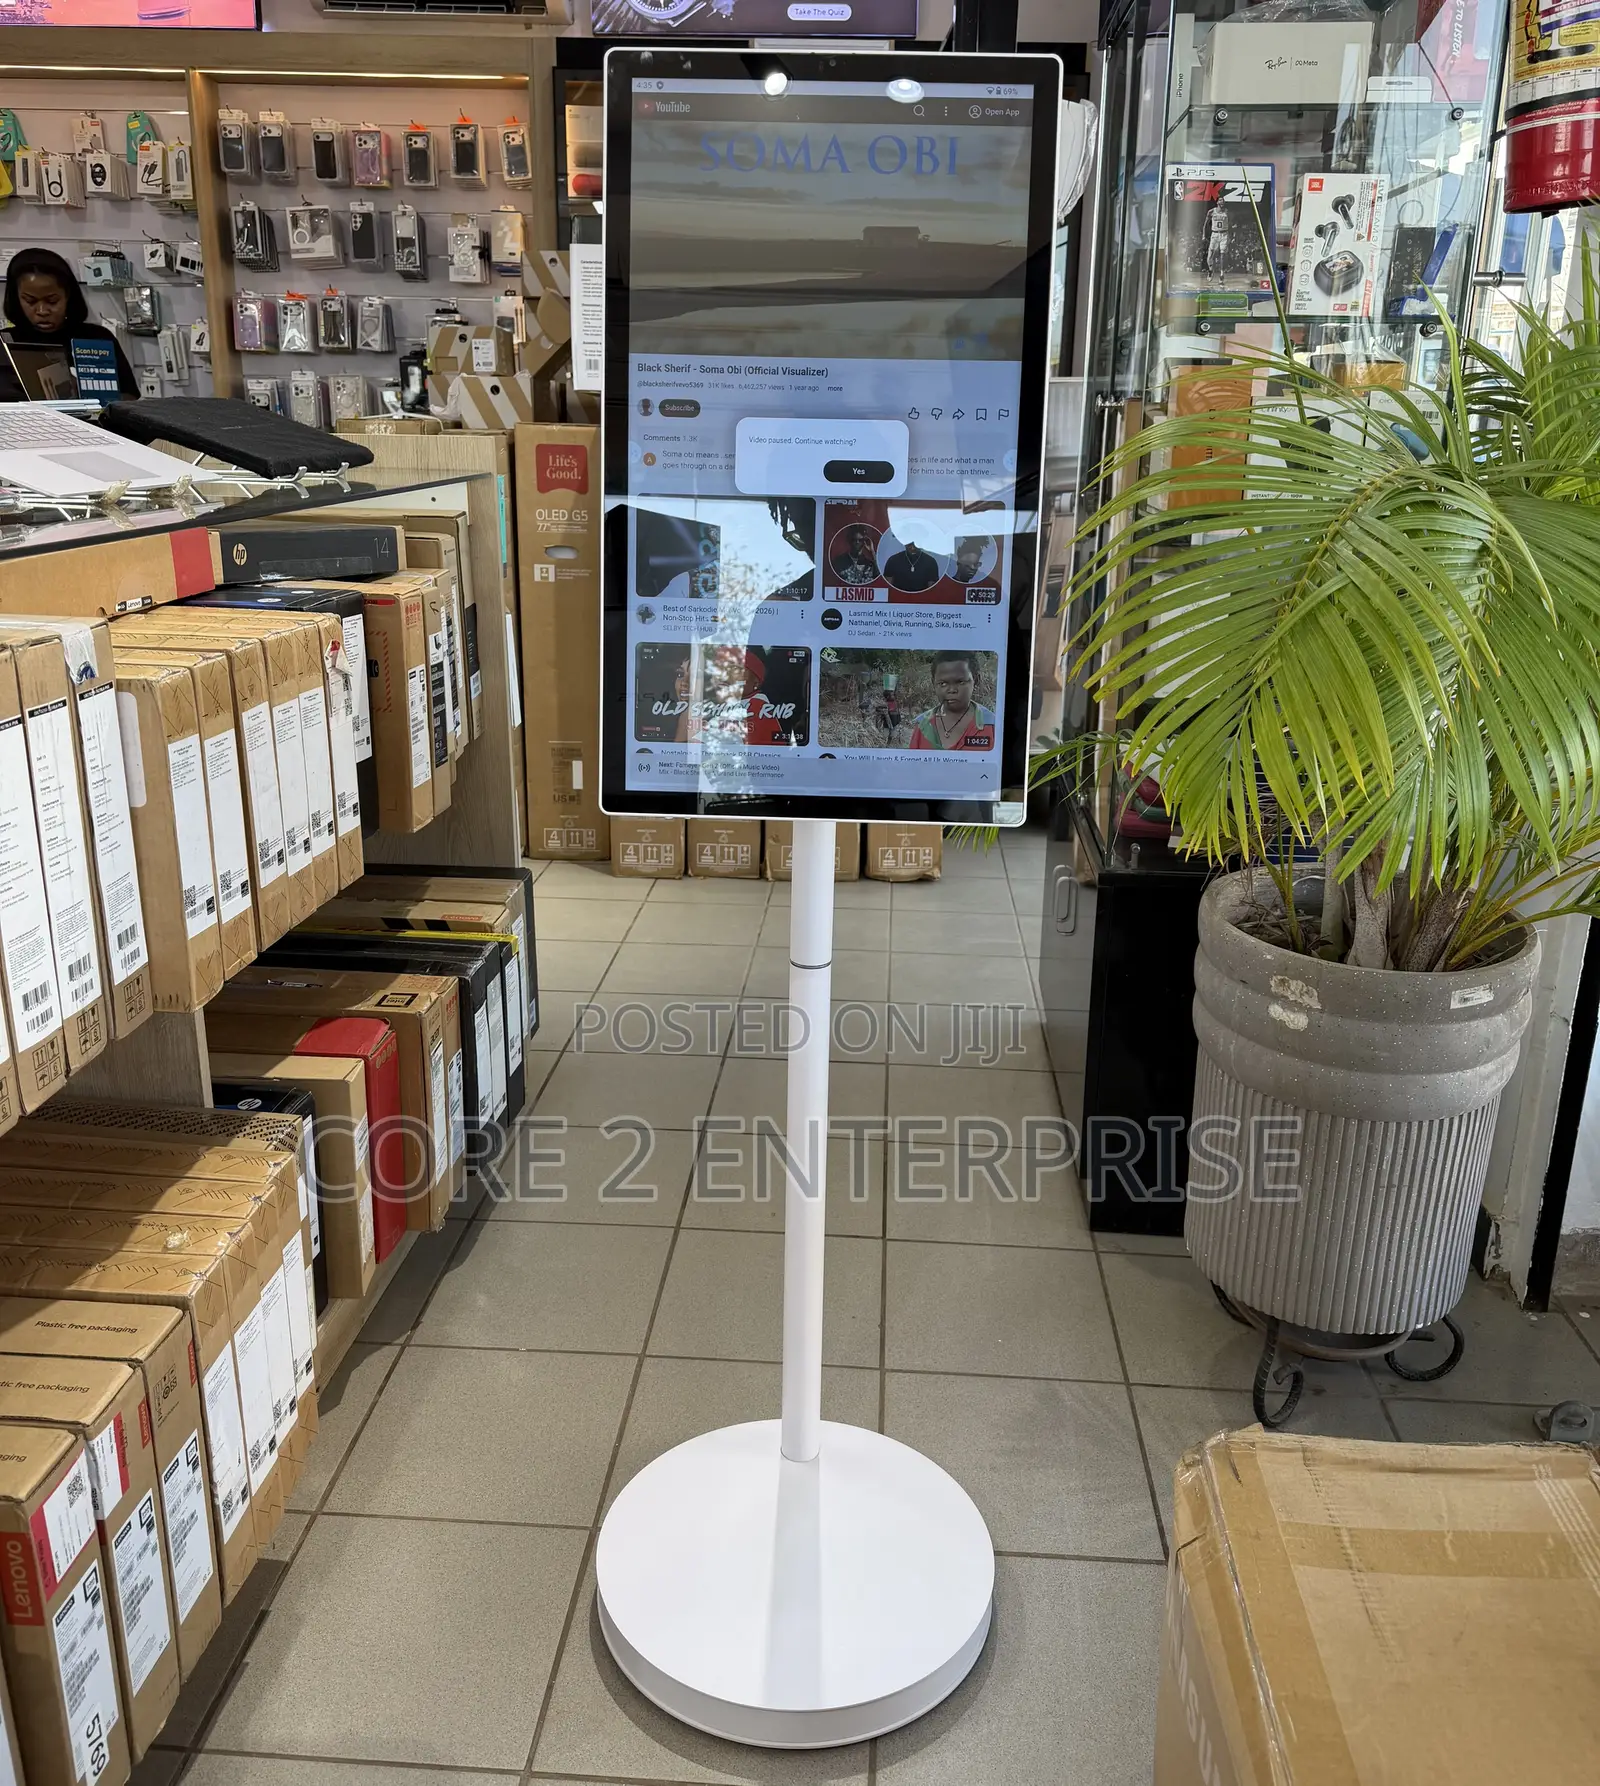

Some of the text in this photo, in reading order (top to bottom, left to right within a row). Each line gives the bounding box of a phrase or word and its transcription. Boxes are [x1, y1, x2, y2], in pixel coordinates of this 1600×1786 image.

[795, 8, 845, 17] Take The Quiz
[636, 81, 1018, 96] 4:35 69%
[1176, 73, 1184, 98] iPhone
[656, 101, 1020, 118] YouTube Open App
[700, 132, 960, 176] SOMA OBI
[1187, 169, 1216, 177] PS5
[637, 363, 662, 373] Black
[664, 364, 691, 374] Sherif
[699, 364, 725, 374] Soma
[727, 365, 742, 374] Obi
[744, 365, 779, 376] (Official
[780, 366, 829, 378] Visualizer)
[665, 404, 695, 412] Subscribe
[643, 434, 680, 442] Comments
[768, 437, 793, 445] paused.
[824, 438, 856, 446] watching?
[662, 450, 682, 458] Soma
[548, 454, 578, 467] Life's
[680, 462, 707, 470] through
[852, 467, 866, 475] Yes
[546, 468, 582, 480] Good.
[536, 508, 588, 522] OLED G5
[233, 537, 390, 565] hp 14
[836, 587, 874, 601] LASMID
[663, 604, 678, 612] Best
[662, 615, 694, 623] Non-Stop
[892, 611, 914, 620] Liquor
[915, 612, 934, 620] Store,
[936, 612, 962, 620] Biggest
[848, 620, 882, 628] Nathaniel,
[884, 620, 904, 628] Olivia,
[904, 621, 934, 630] Running,
[935, 622, 951, 630] Sika,
[652, 700, 688, 716] OLD
[758, 702, 796, 720] RNB
[550, 830, 558, 840] 4
[626, 846, 634, 856] 4
[703, 846, 712, 856] 4
[884, 850, 894, 860] 4
[35, 1320, 66, 1330] Plastic
[88, 1324, 138, 1334] packaging
[14, 1381, 36, 1389] free
[36, 1384, 90, 1394] packaging
[6, 1540, 32, 1618] Lenovo
